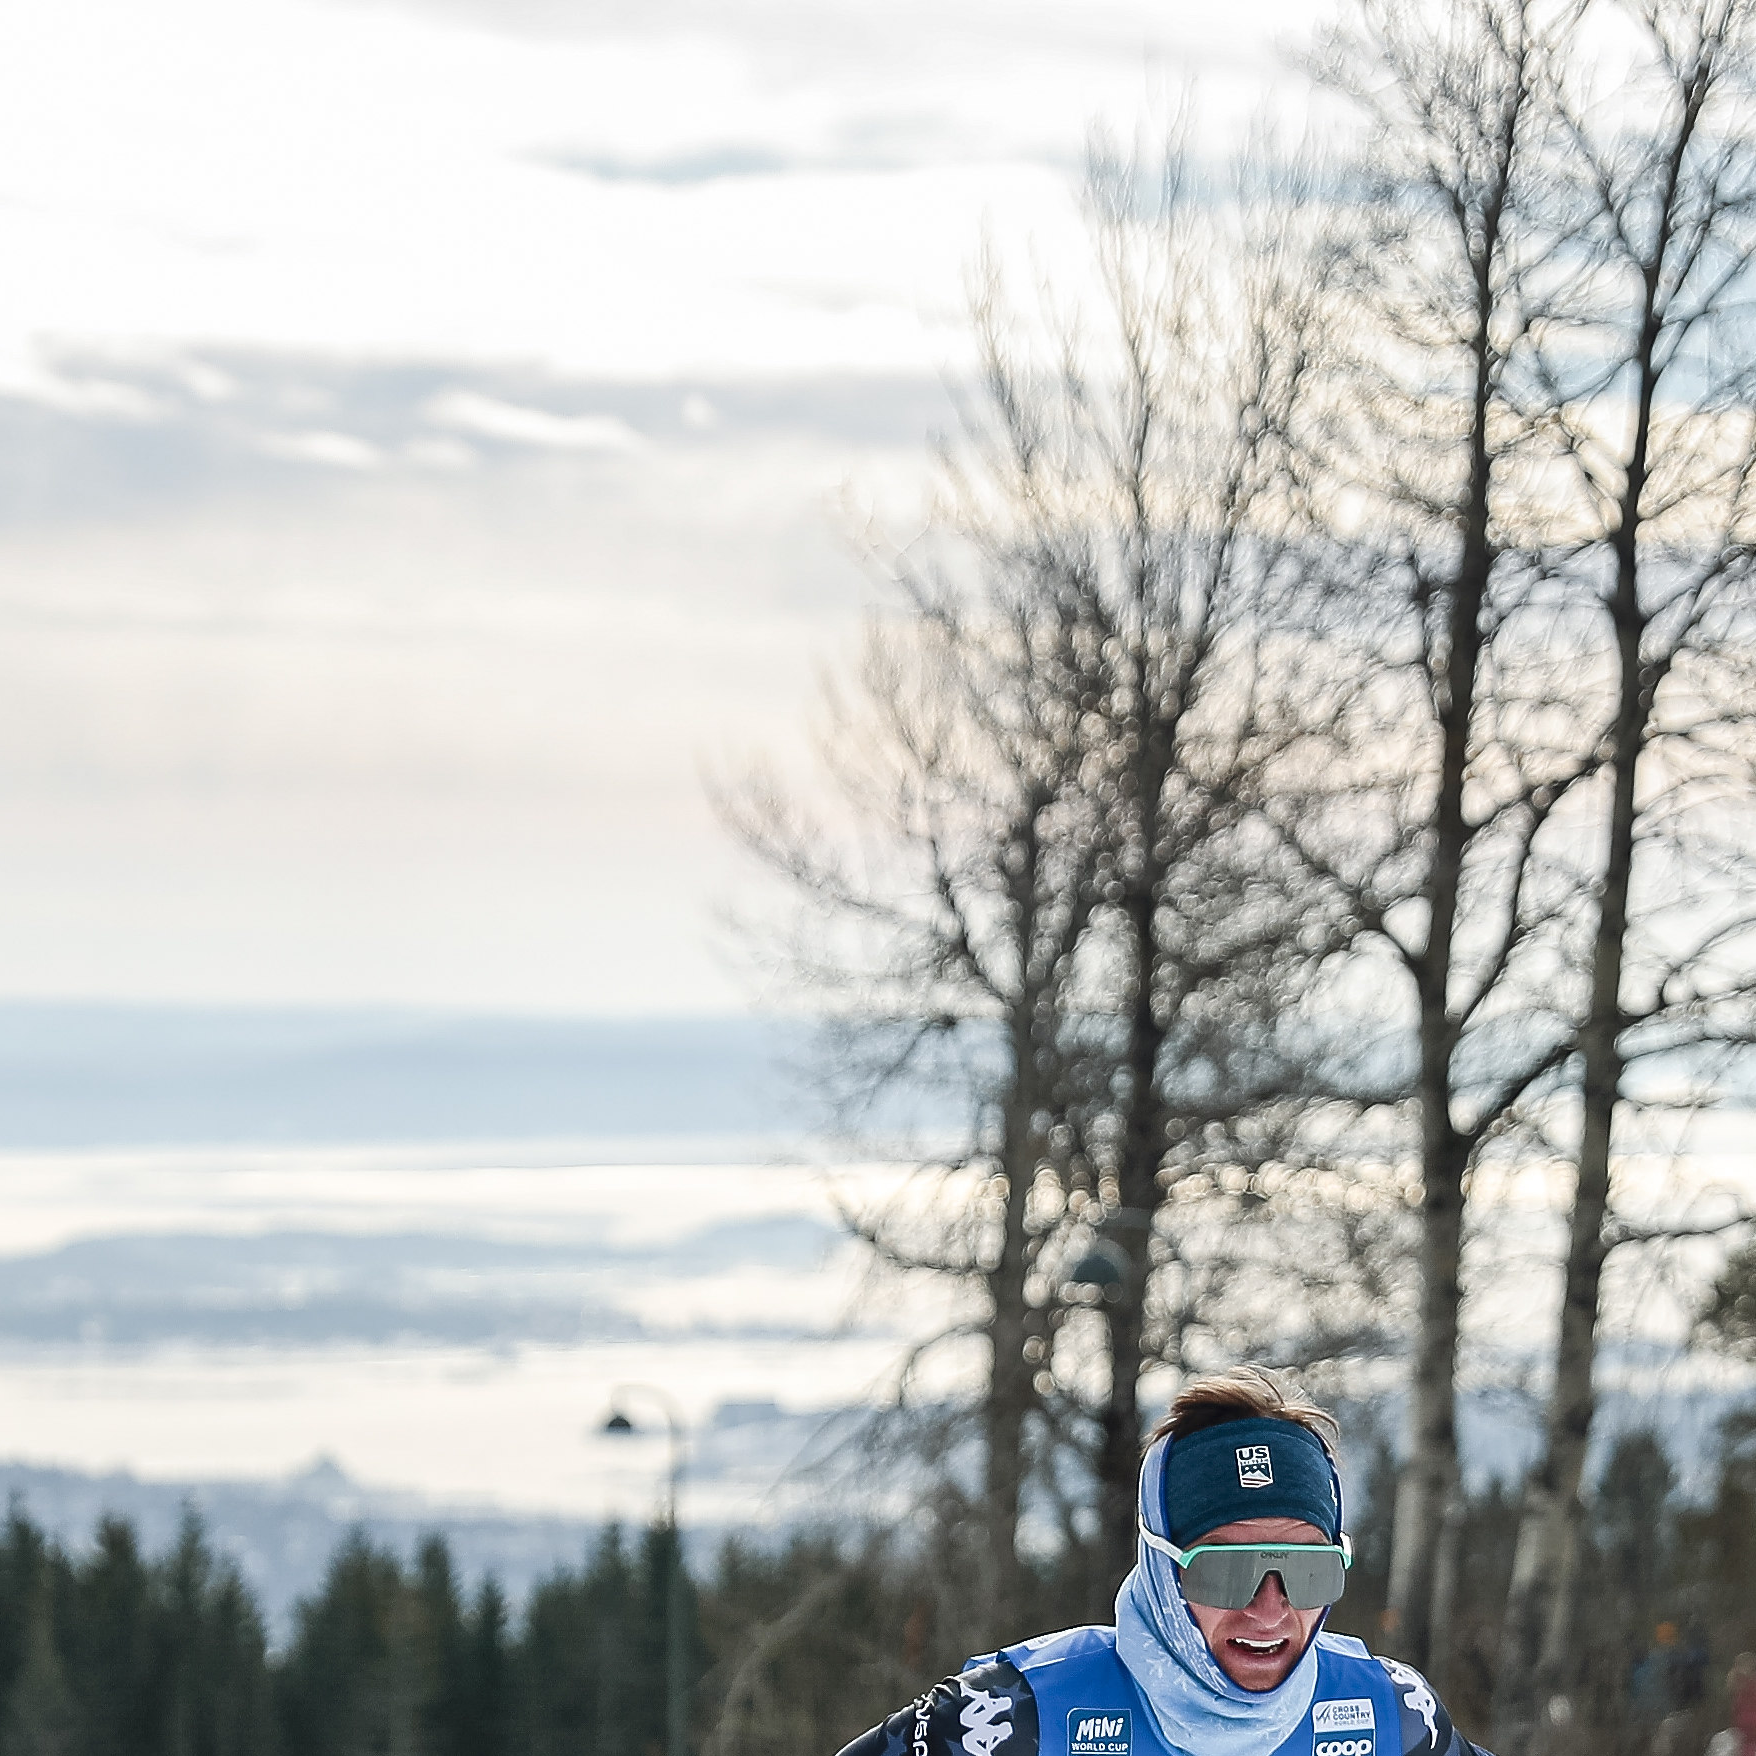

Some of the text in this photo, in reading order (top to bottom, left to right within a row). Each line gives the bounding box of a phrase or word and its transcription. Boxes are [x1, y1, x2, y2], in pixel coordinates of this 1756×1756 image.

[1238, 1447, 1268, 1460] US
[1332, 1704, 1360, 1713] CROSS
[1332, 1711, 1371, 1721] COUNTRY
[1071, 1742, 1129, 1752] WORLD CUP
